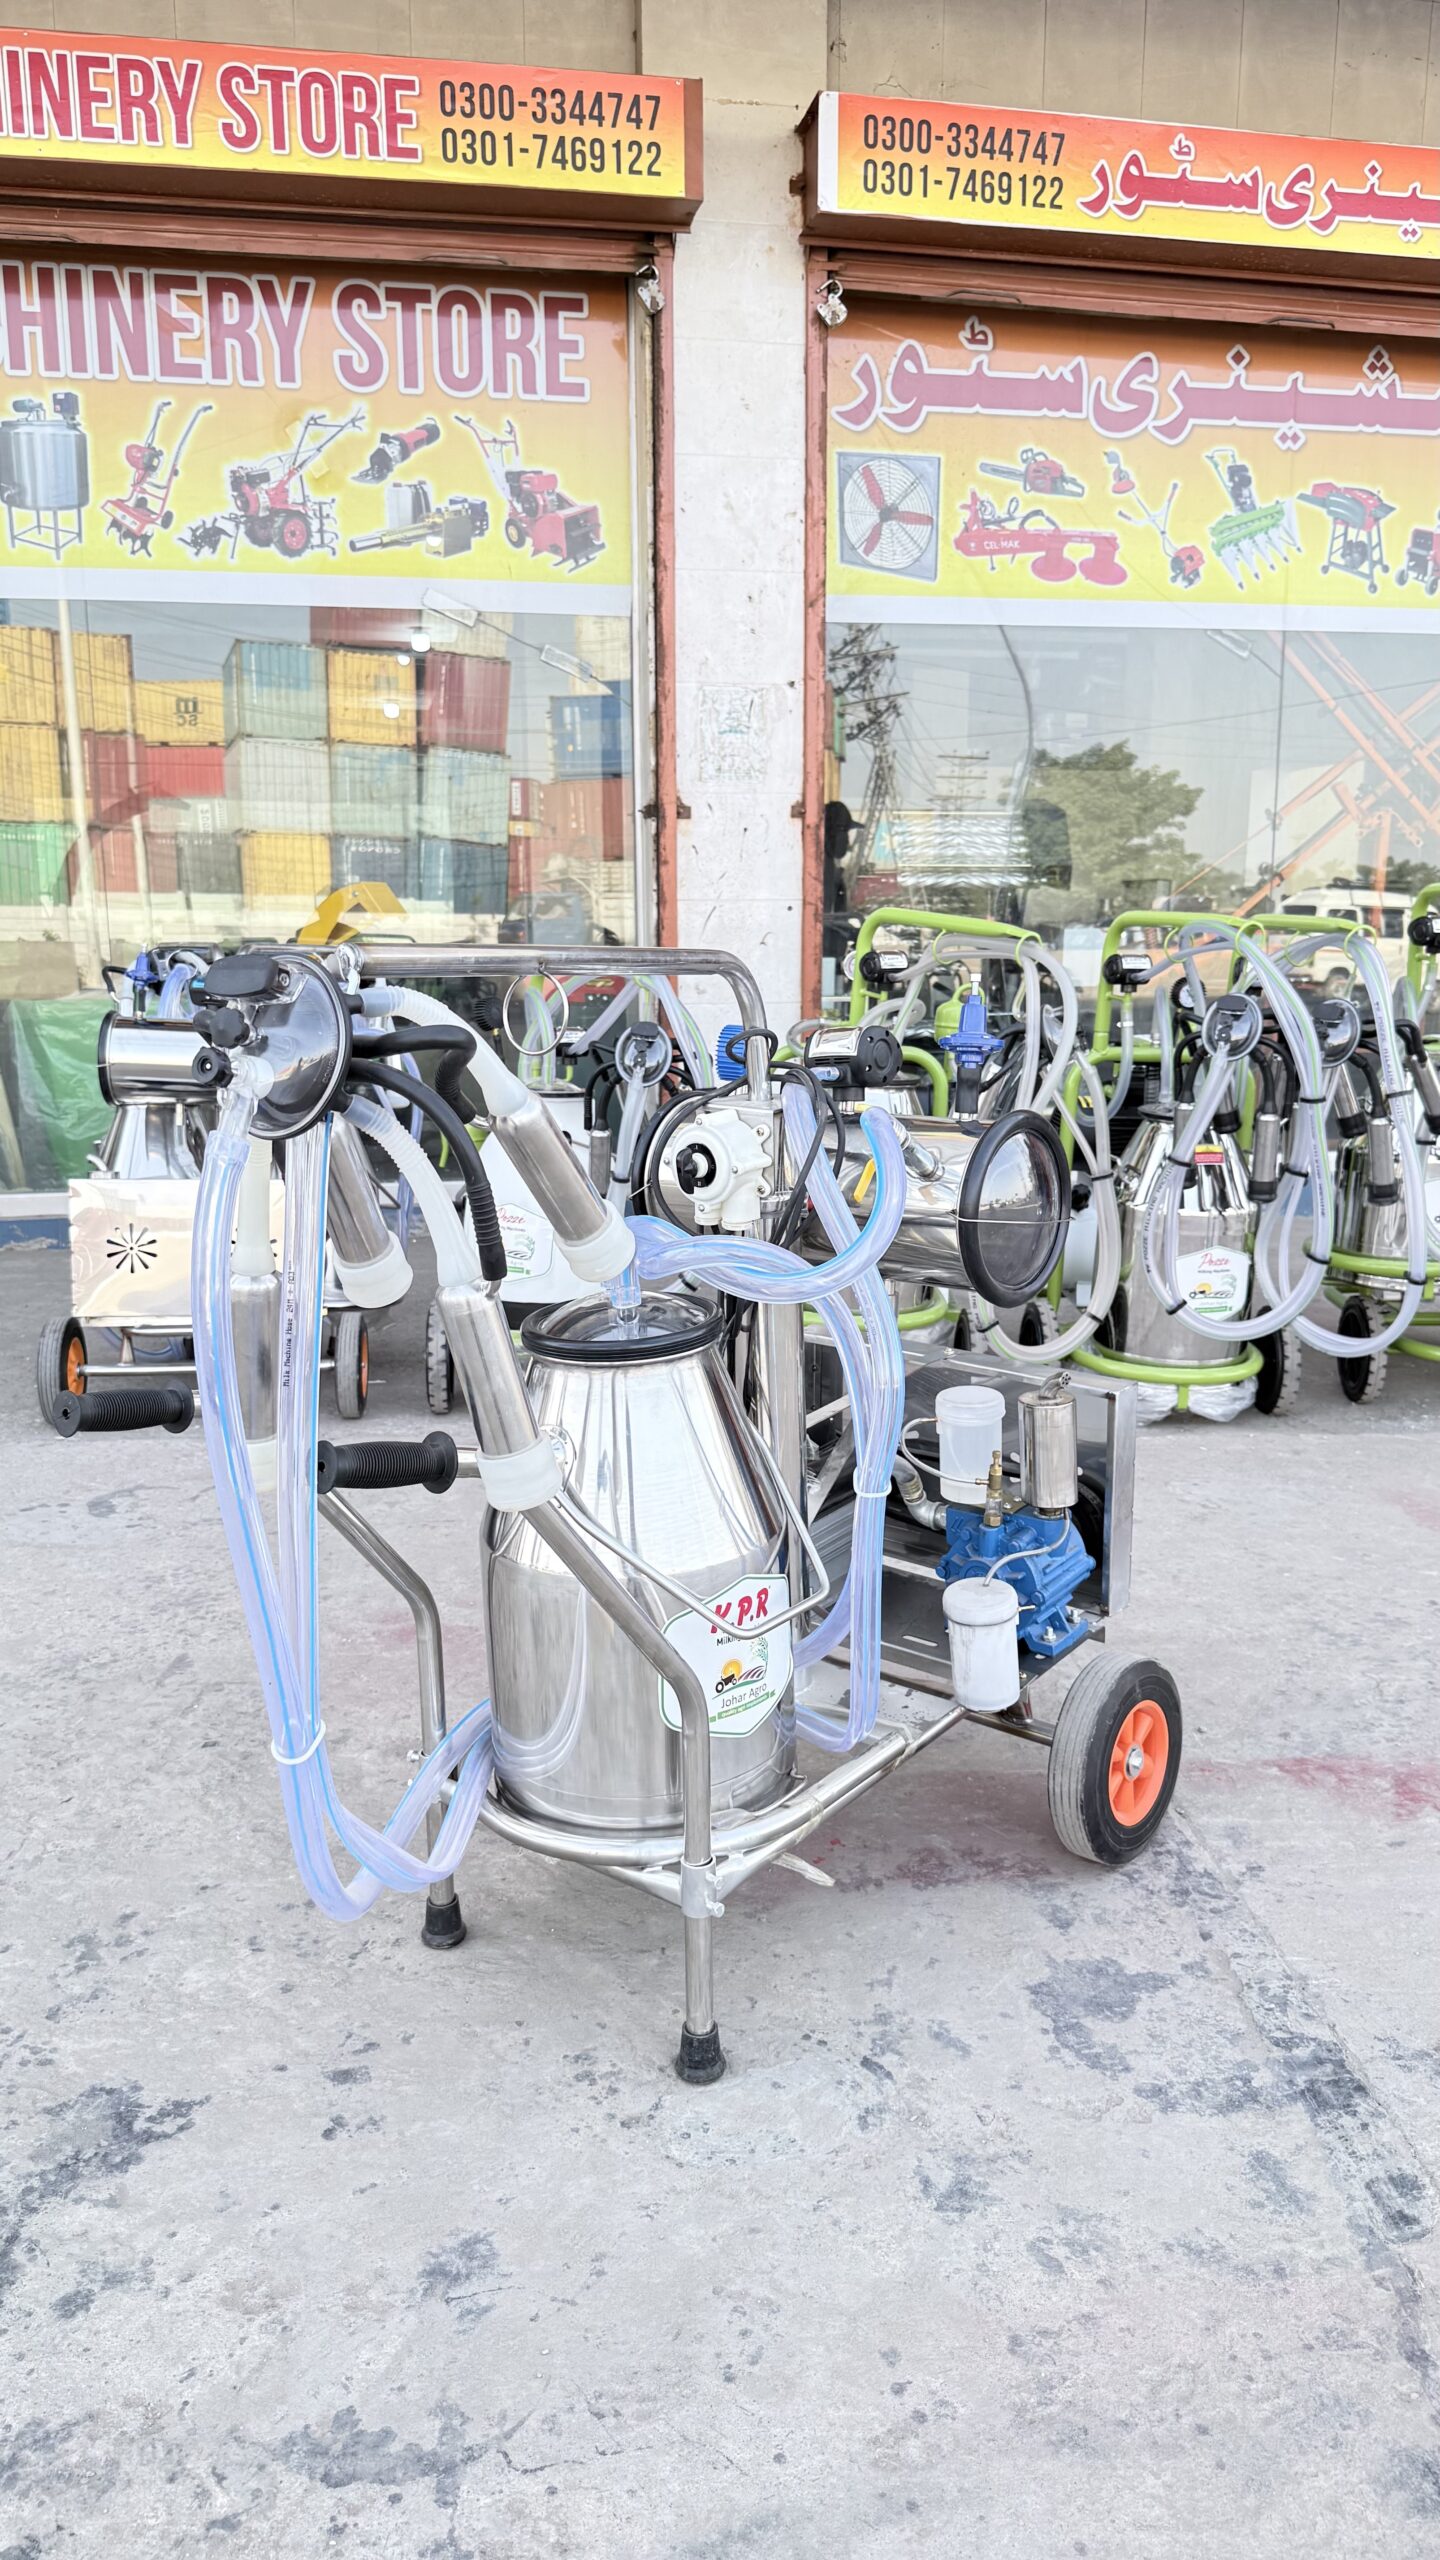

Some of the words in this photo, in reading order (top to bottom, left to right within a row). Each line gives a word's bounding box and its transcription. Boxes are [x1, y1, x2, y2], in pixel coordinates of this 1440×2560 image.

[0, 47, 202, 148] INERY
[217, 62, 423, 163] STORE
[439, 80, 661, 131] 0300-3344747
[441, 127, 662, 177] 0301-7469122
[864, 114, 1065, 166] 0300-3344747
[863, 159, 1064, 210] 0301-7469122
[1077, 133, 1263, 219] سٹور
[1263, 160, 1440, 241] ینری
[0, 260, 315, 389] HINERY
[332, 279, 590, 403] STORE
[830, 315, 1089, 433] سٹور
[1088, 344, 1440, 450] شینری
[285, 1318, 293, 1335] Hose
[284, 1338, 292, 1367] Machine
[283, 1370, 291, 1387] Milk
[721, 1692, 747, 1709] Johar
[748, 1683, 767, 1698] Agro
